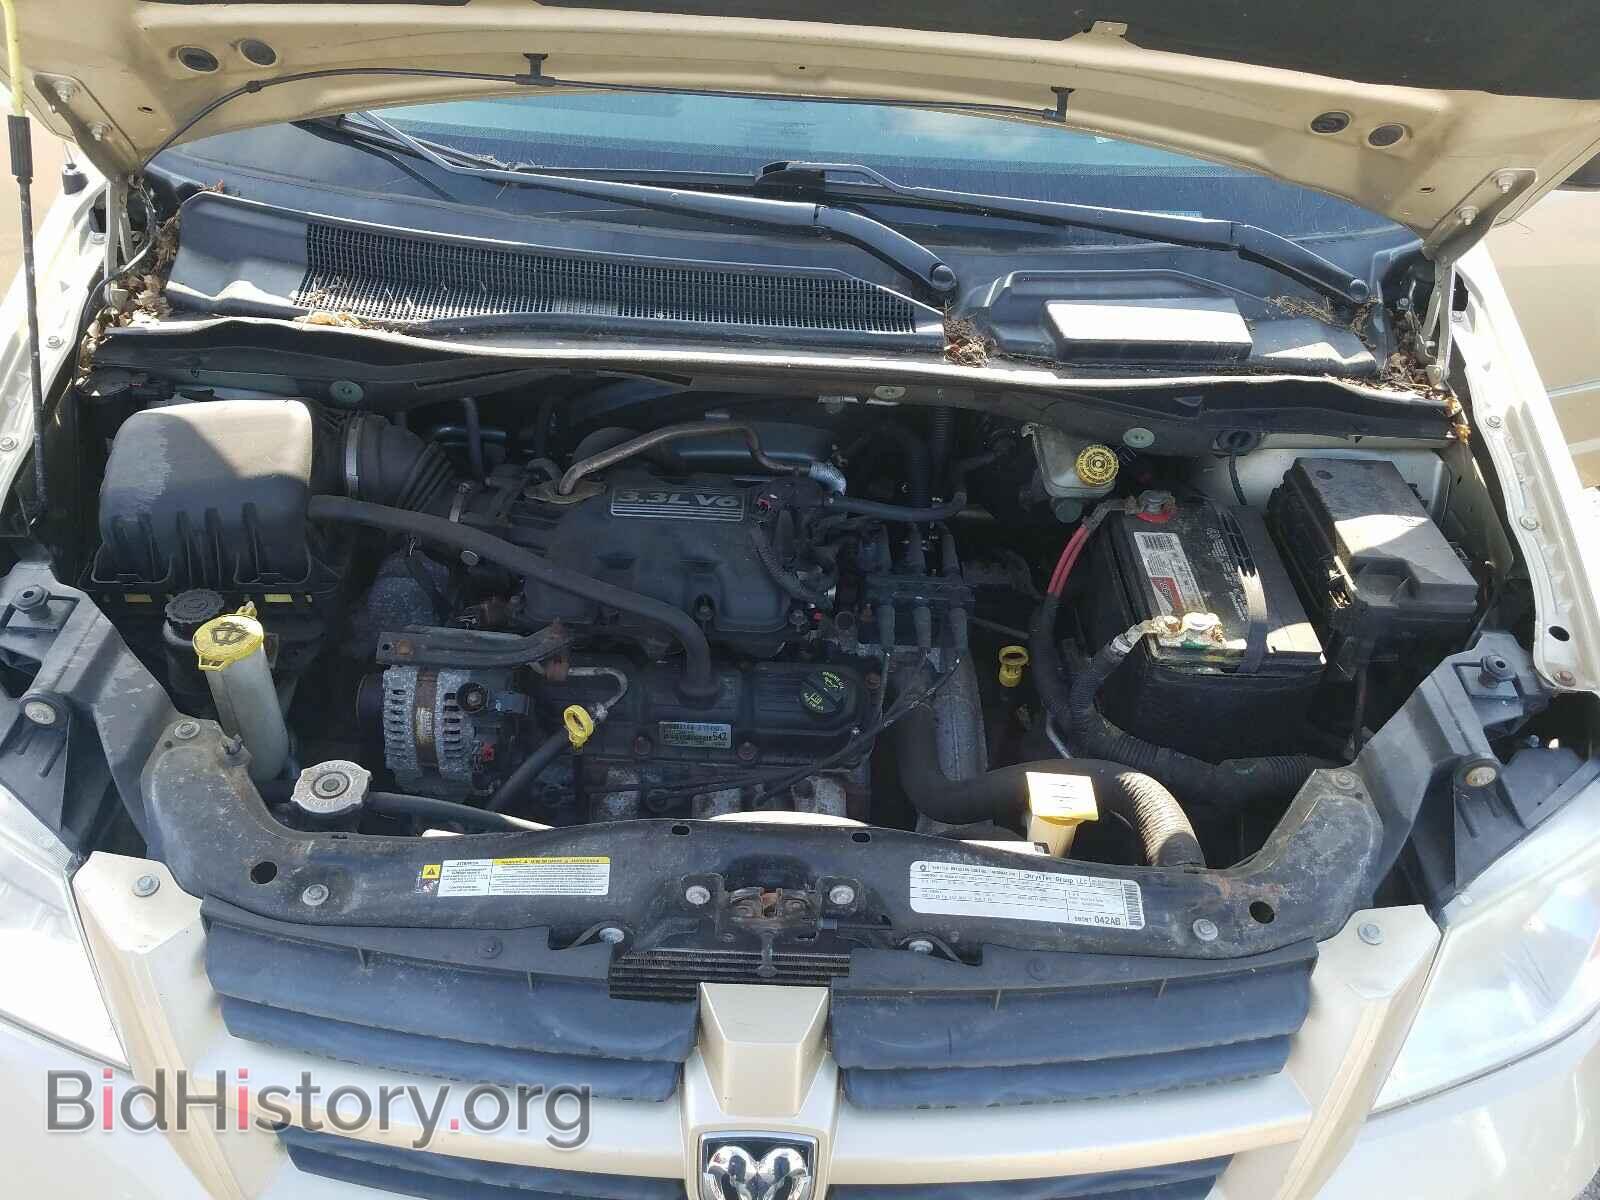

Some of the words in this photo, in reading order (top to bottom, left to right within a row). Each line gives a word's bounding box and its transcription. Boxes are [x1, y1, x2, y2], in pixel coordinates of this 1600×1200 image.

[618, 490, 690, 504] 3.3L
[695, 494, 739, 507] V6
[1055, 876, 1074, 885] Group
